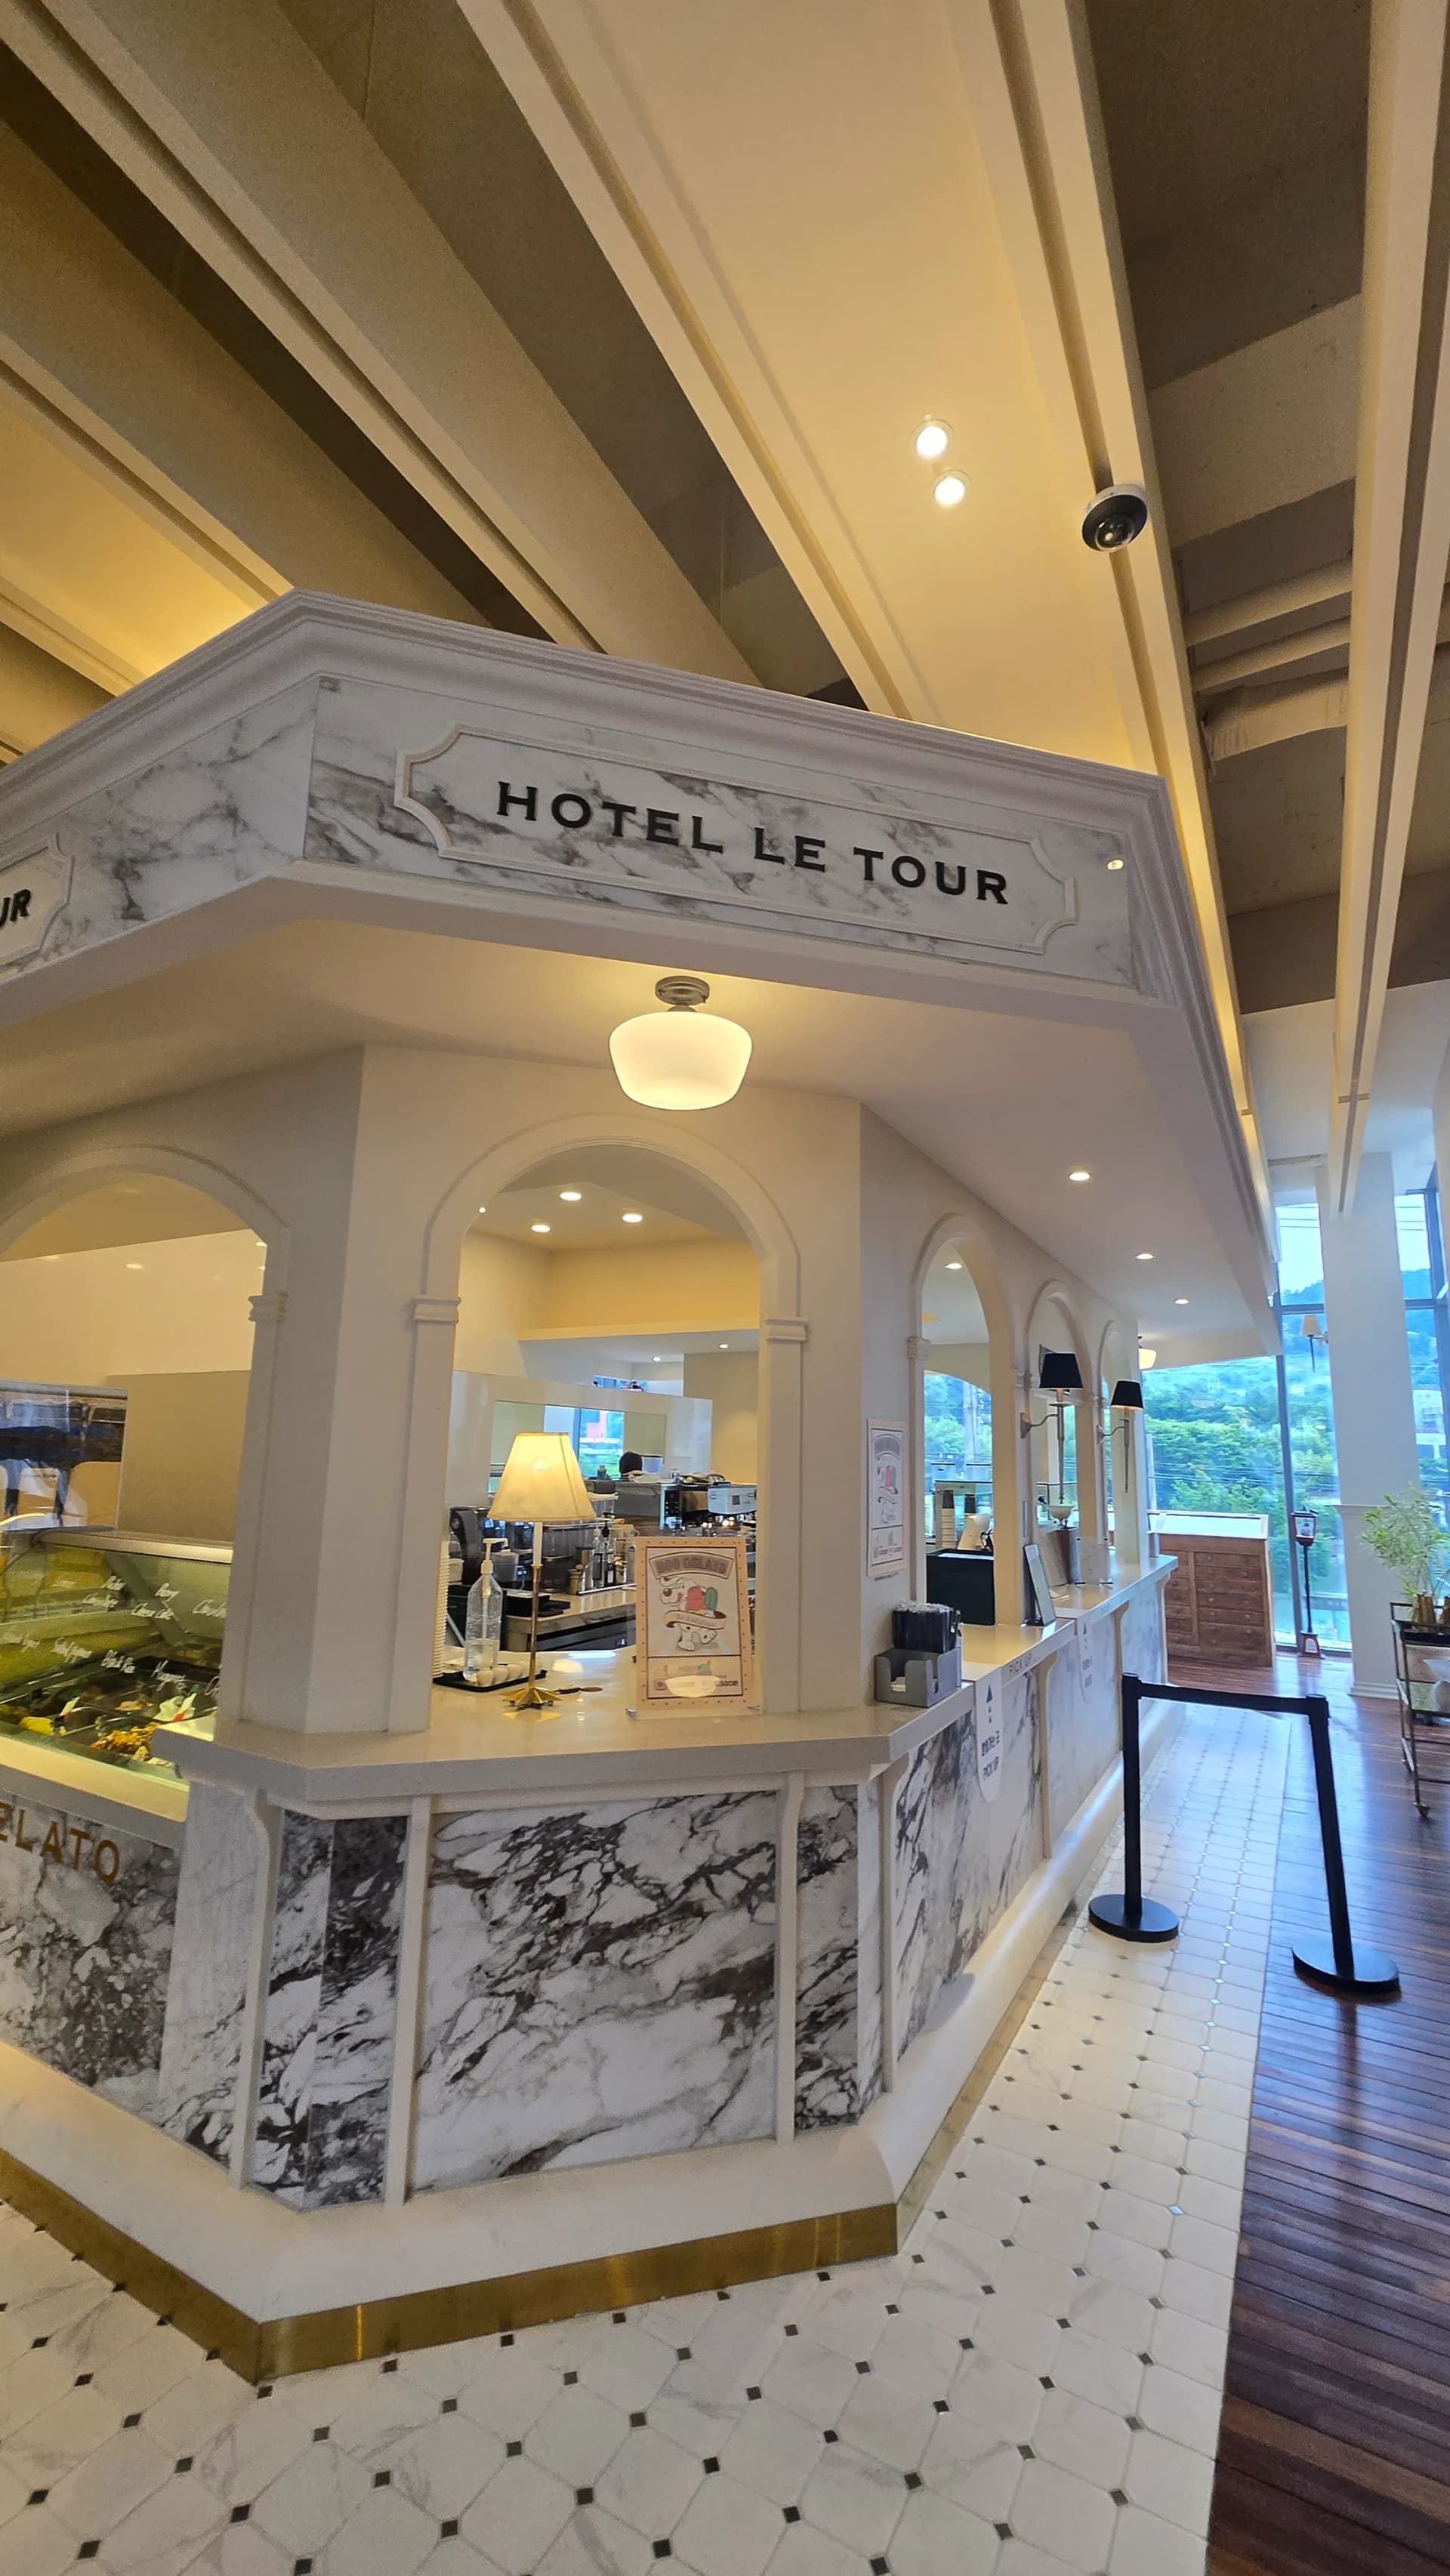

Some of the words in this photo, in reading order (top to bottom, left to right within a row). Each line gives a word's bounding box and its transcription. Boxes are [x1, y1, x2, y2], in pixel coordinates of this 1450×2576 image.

[497, 781, 723, 854] HOTEL
[754, 827, 826, 873] LE
[853, 847, 1009, 905] TOUR
[0, 1801, 119, 1884] ELATO
